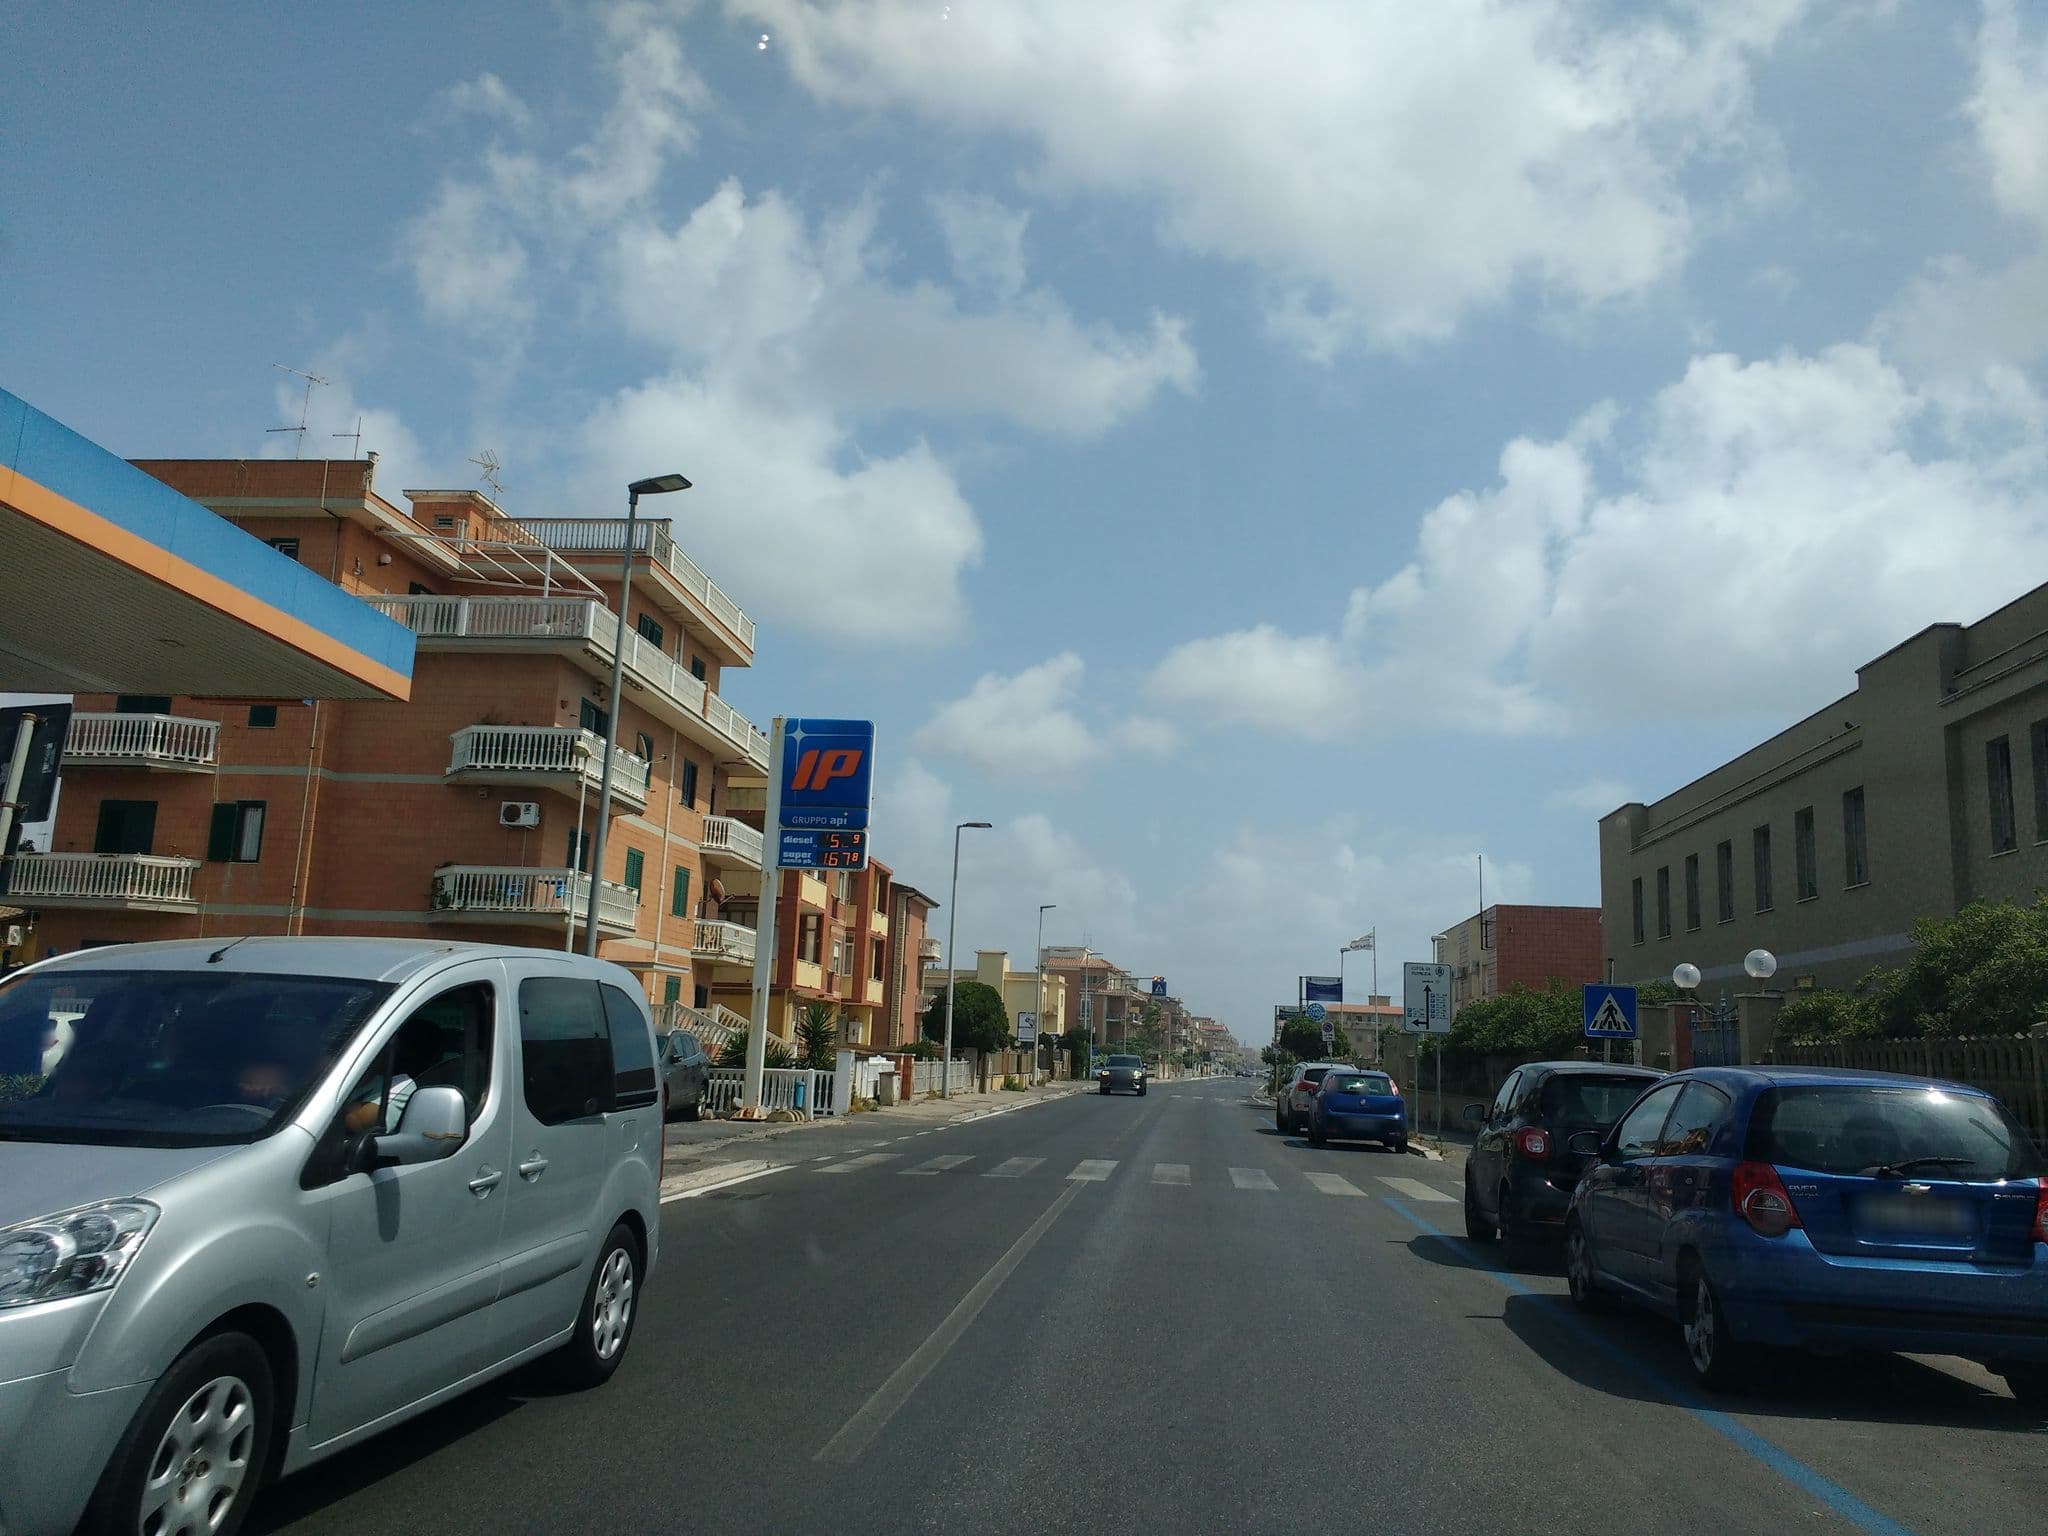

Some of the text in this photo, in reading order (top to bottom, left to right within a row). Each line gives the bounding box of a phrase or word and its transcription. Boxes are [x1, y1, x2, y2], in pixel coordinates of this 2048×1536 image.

[791, 749, 863, 791] IP
[792, 812, 848, 827] GRUPPO api
[783, 836, 813, 844] diesel
[783, 851, 812, 860] super
